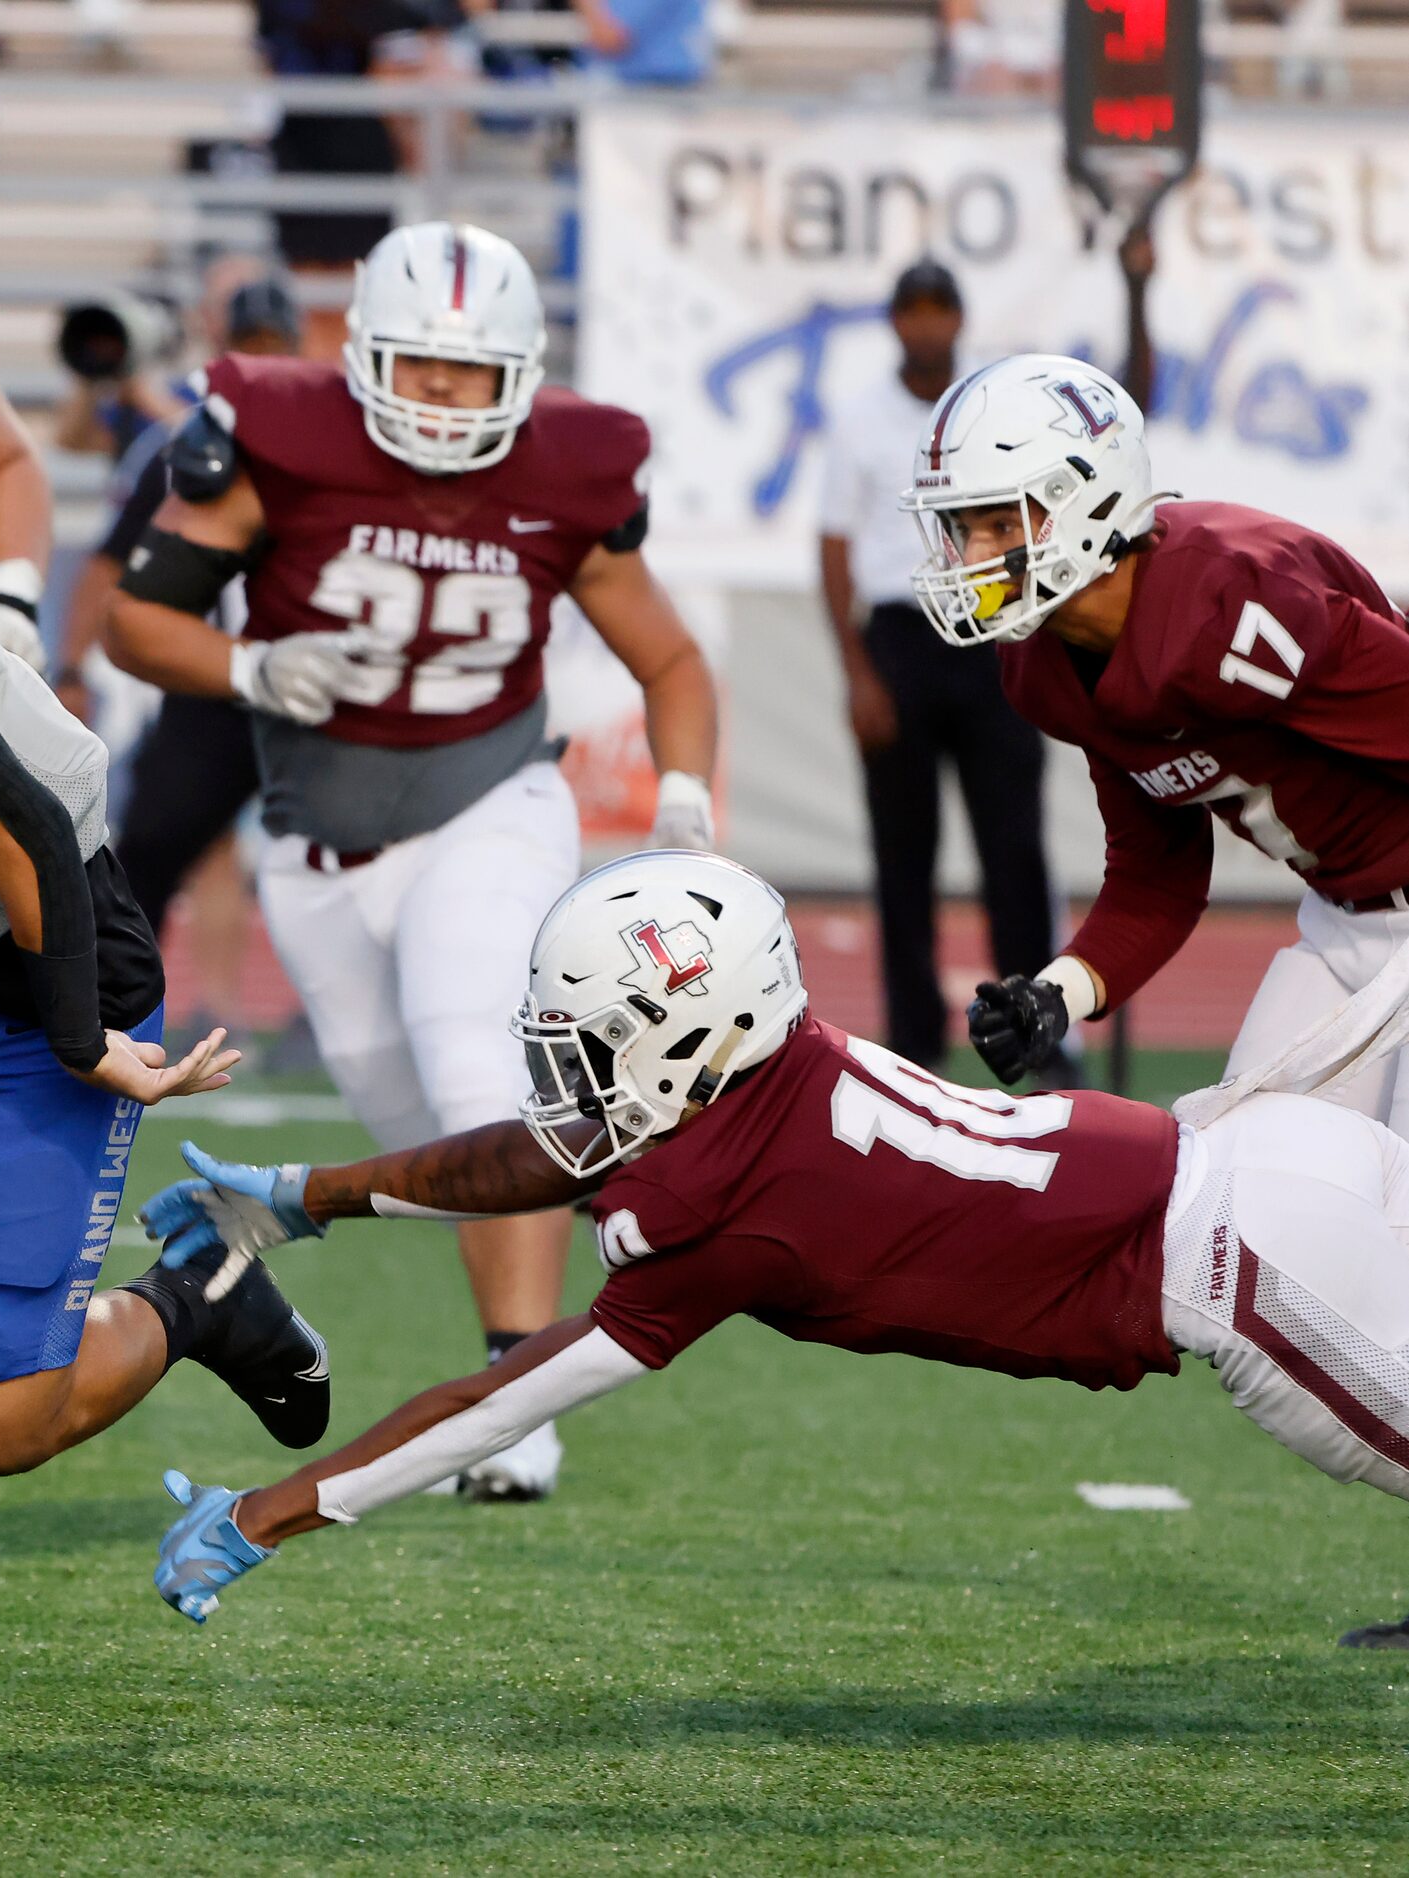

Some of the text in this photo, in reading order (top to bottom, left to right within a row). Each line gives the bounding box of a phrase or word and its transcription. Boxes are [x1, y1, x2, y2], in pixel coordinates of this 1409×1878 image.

[667, 145, 1407, 264] Plano est
[348, 525, 519, 576] FARMERS
[1219, 599, 1306, 700] 17
[64, 1096, 140, 1311] PLANO WES
[1210, 1225, 1229, 1301] FARMERS
